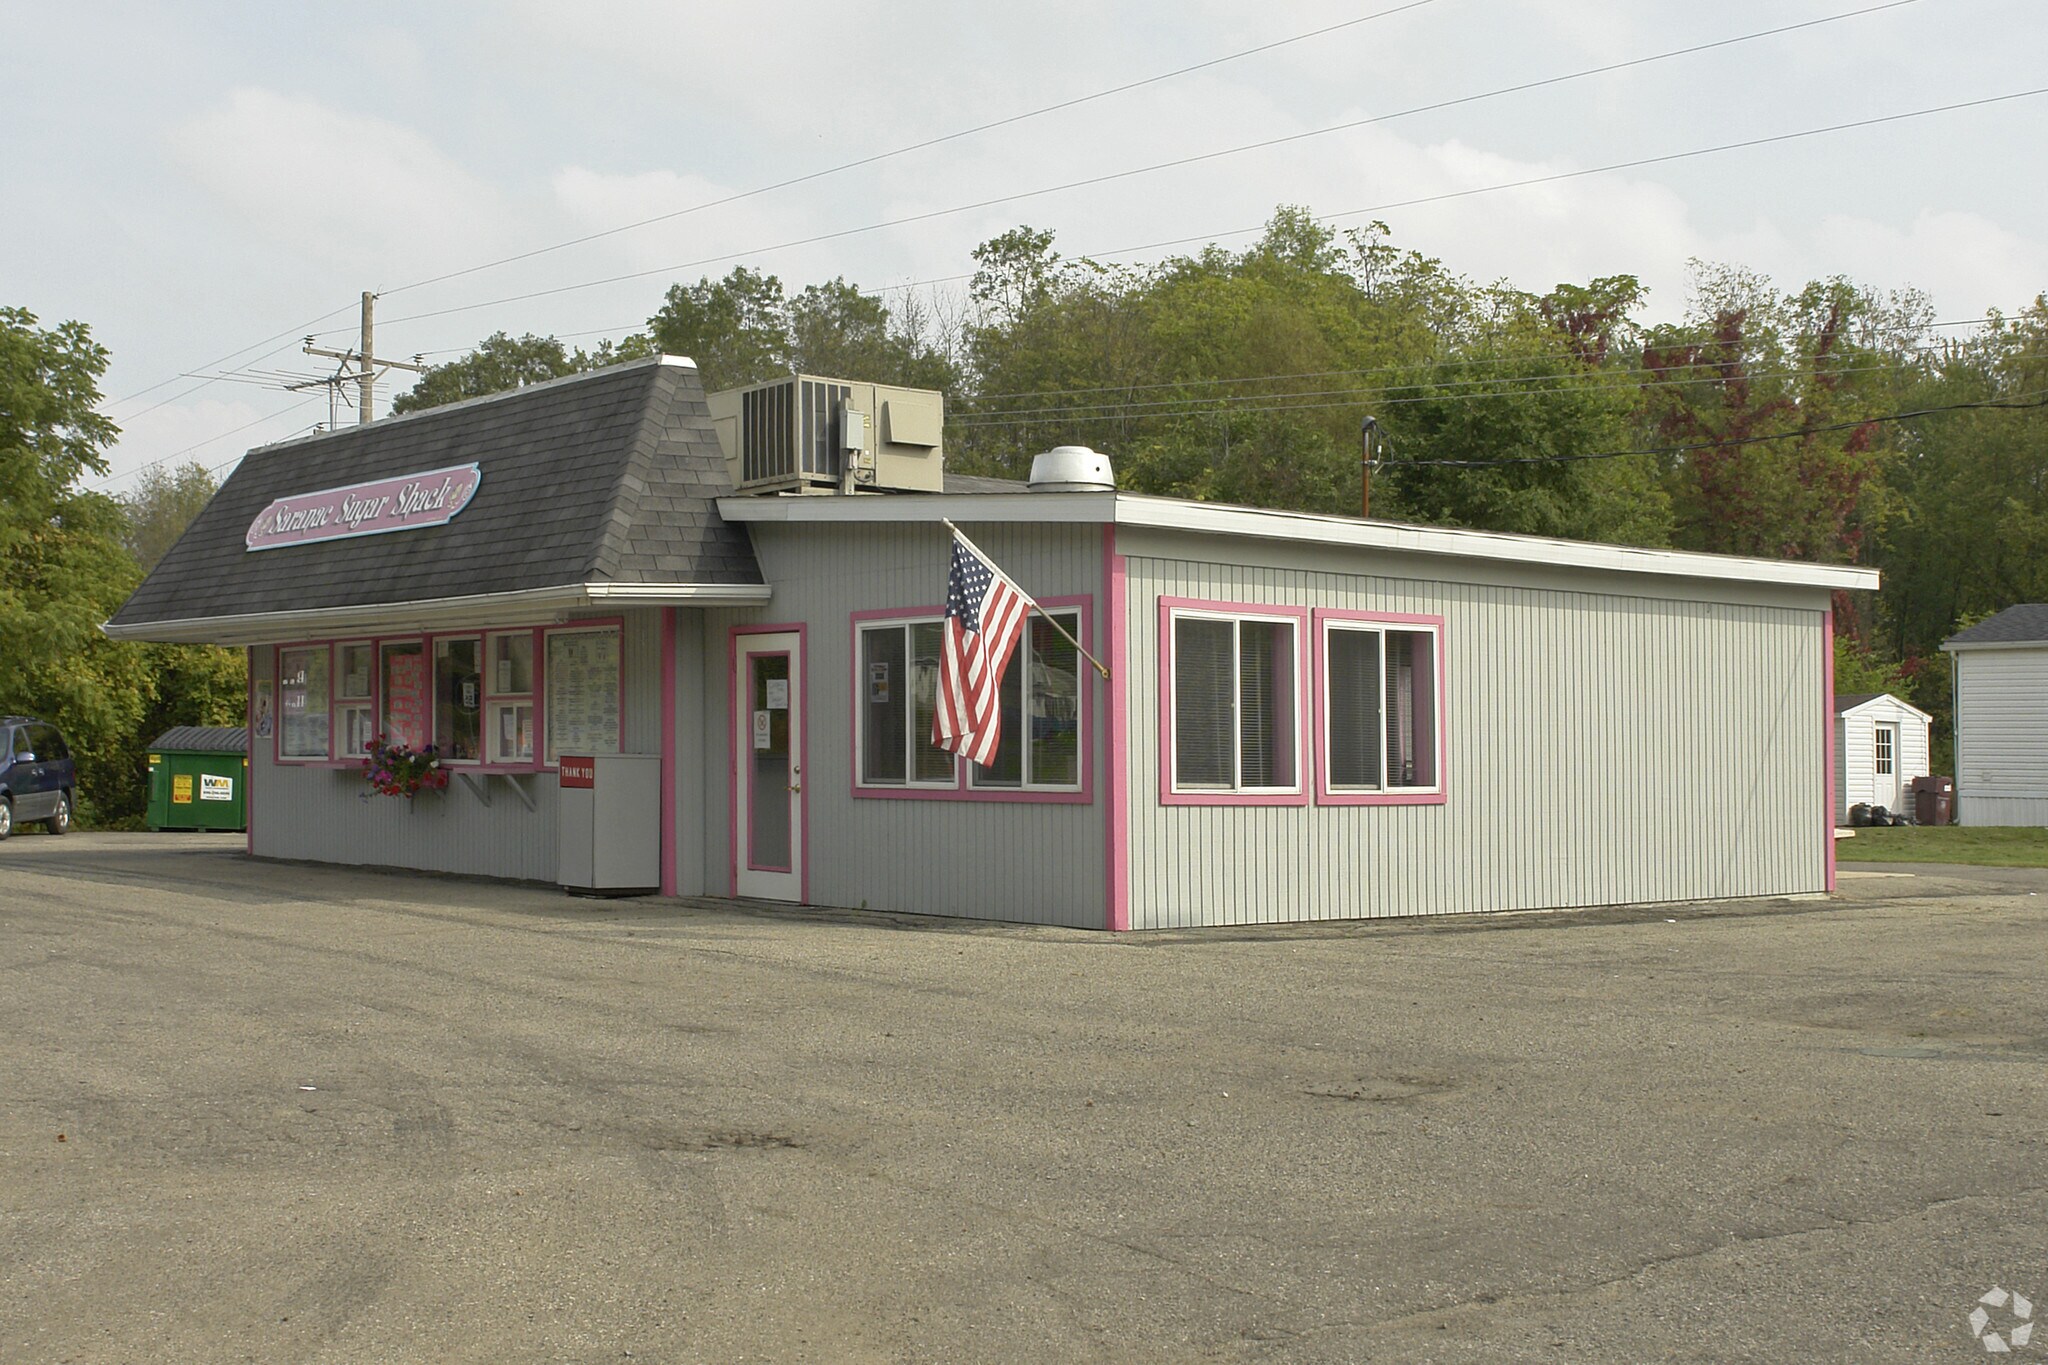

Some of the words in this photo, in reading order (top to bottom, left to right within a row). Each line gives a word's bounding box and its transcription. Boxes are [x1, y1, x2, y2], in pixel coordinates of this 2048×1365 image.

[269, 505, 334, 533] Saranac
[335, 493, 389, 529] Sugar
[391, 477, 451, 516] Shack
[561, 766, 580, 777] THANK
[581, 768, 593, 778] YOU
[204, 778, 229, 788] WM
